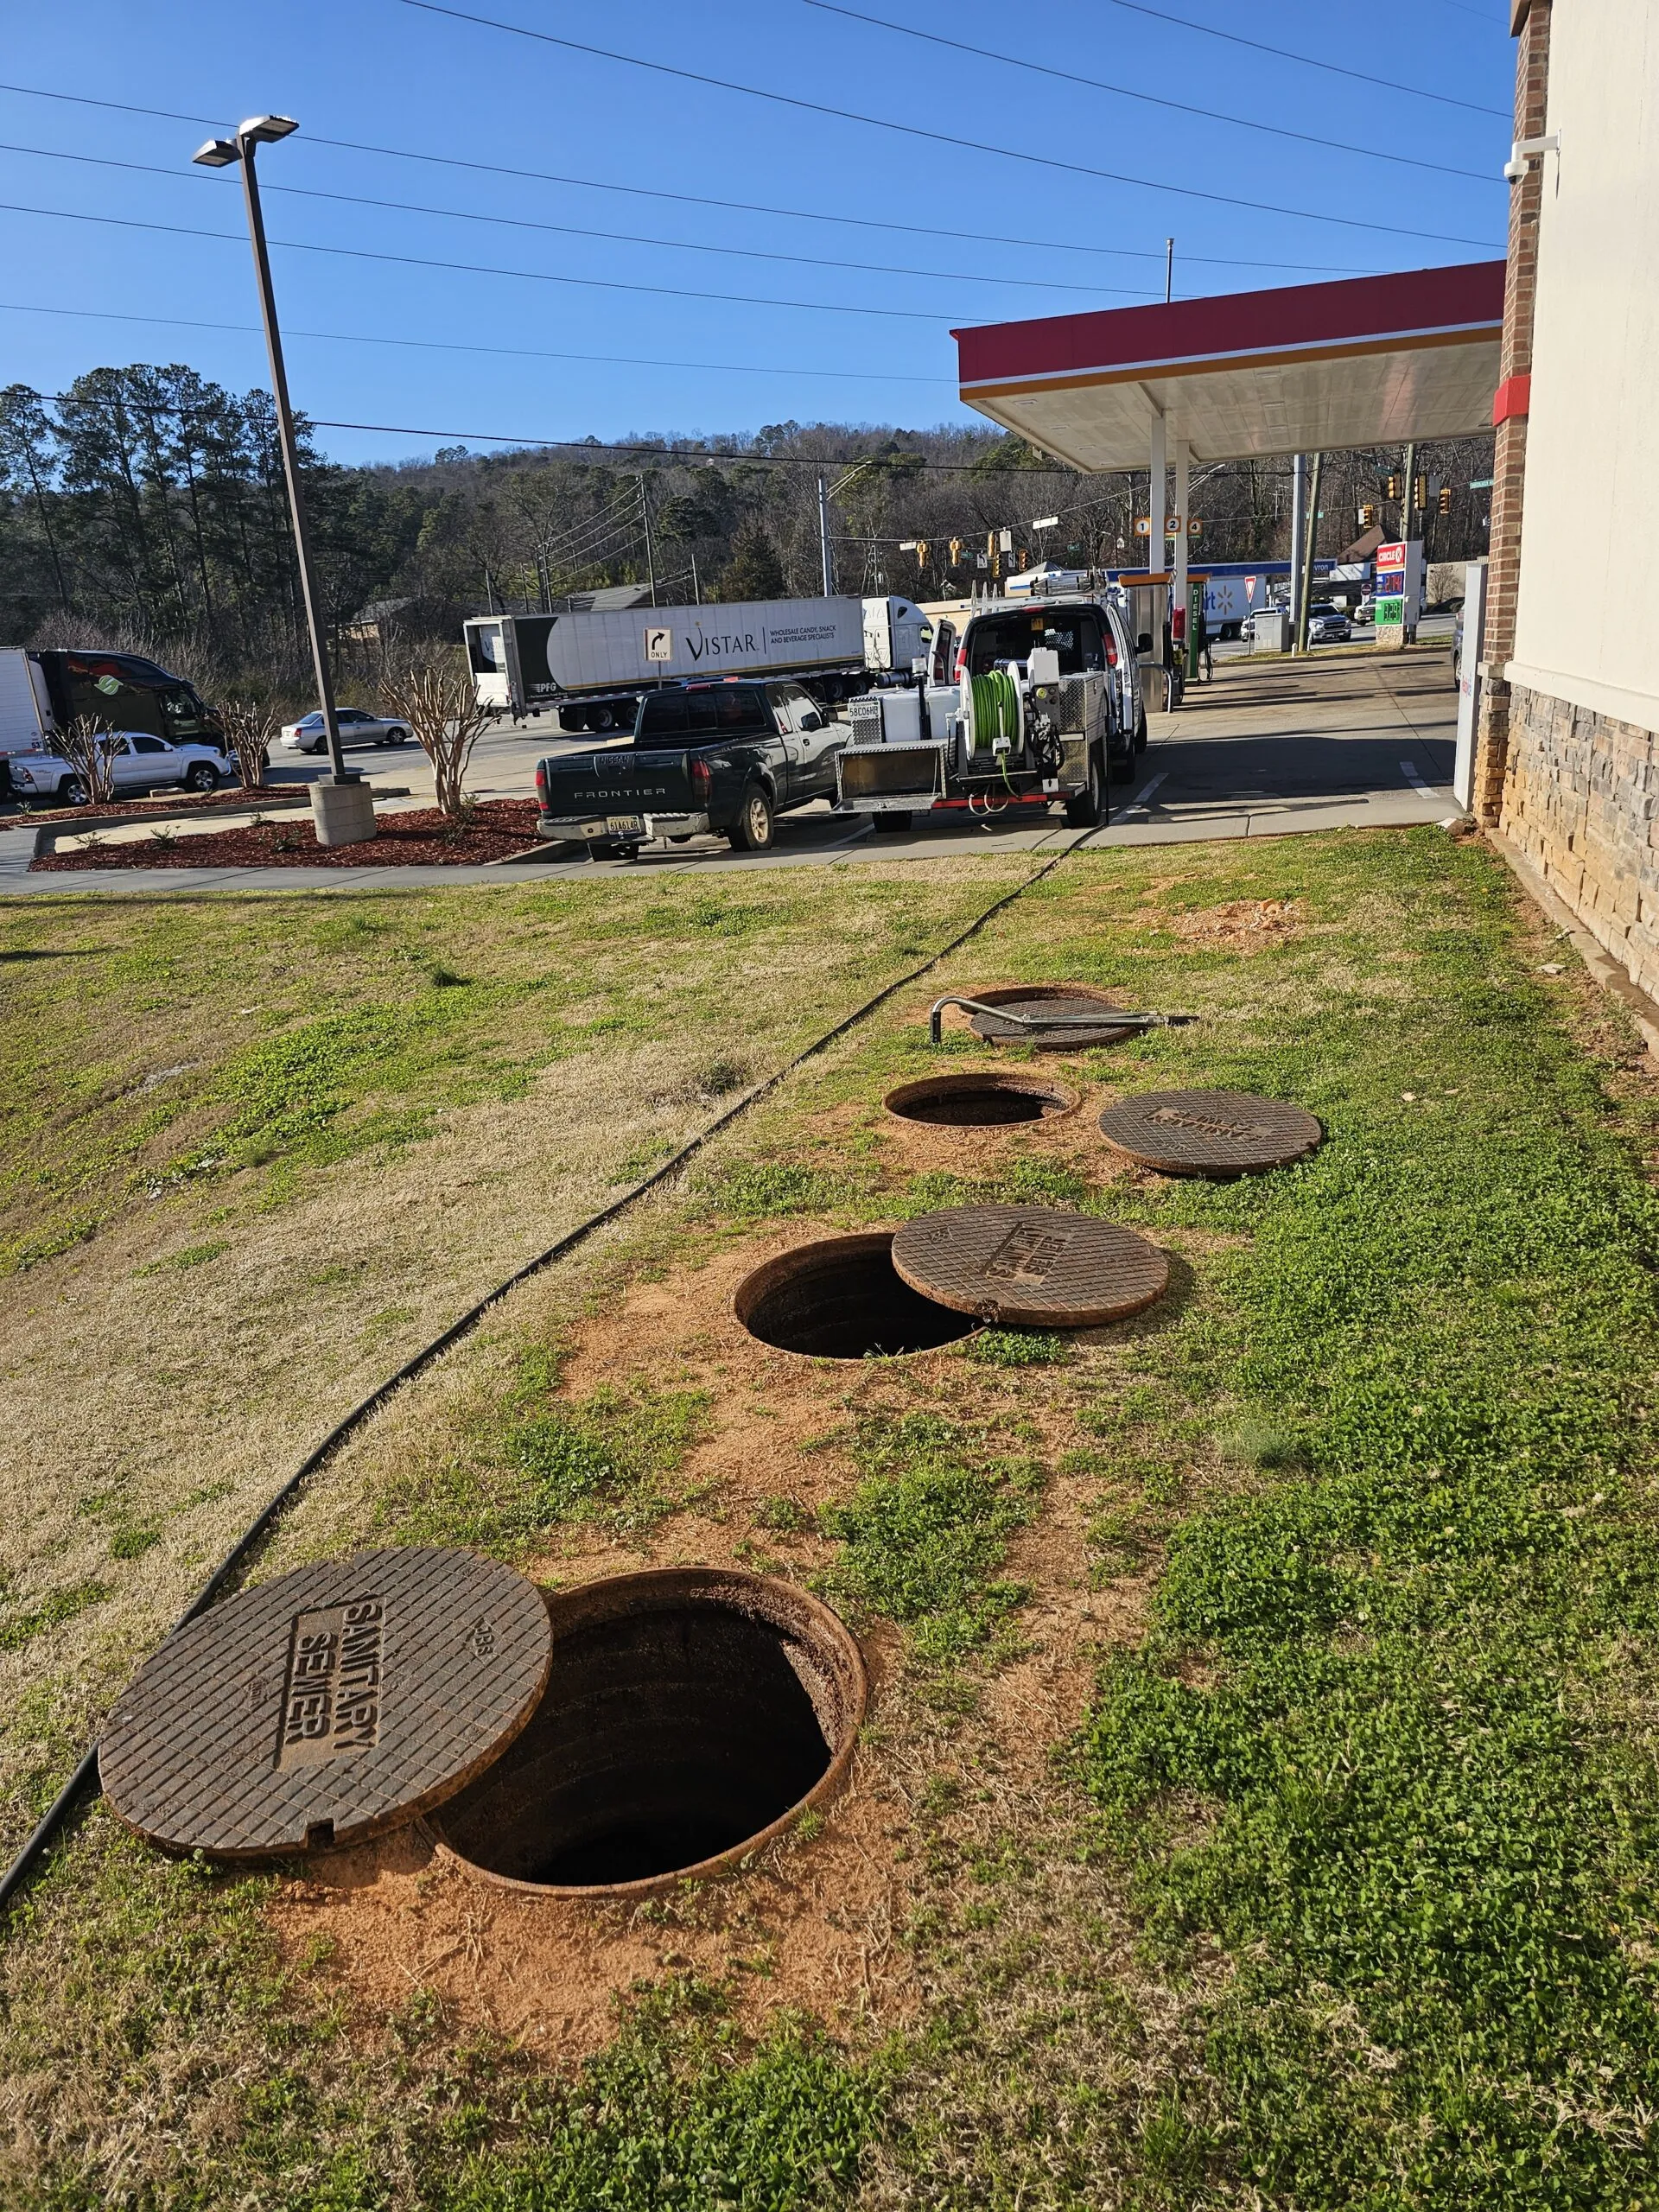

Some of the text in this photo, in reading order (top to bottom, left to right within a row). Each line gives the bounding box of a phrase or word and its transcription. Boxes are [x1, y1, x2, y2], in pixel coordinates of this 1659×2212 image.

[1170, 520, 1176, 529] 2
[1379, 550, 1395, 563] CIRCLE
[769, 627, 799, 637] WHOLESALE
[685, 627, 756, 661] VISTAR
[539, 682, 556, 692] PFG
[574, 788, 666, 798] FRONTIER
[1022, 1236, 1068, 1275] SEWER
[333, 1603, 383, 1750] SANITARY
[284, 1630, 339, 1745] SEWER
